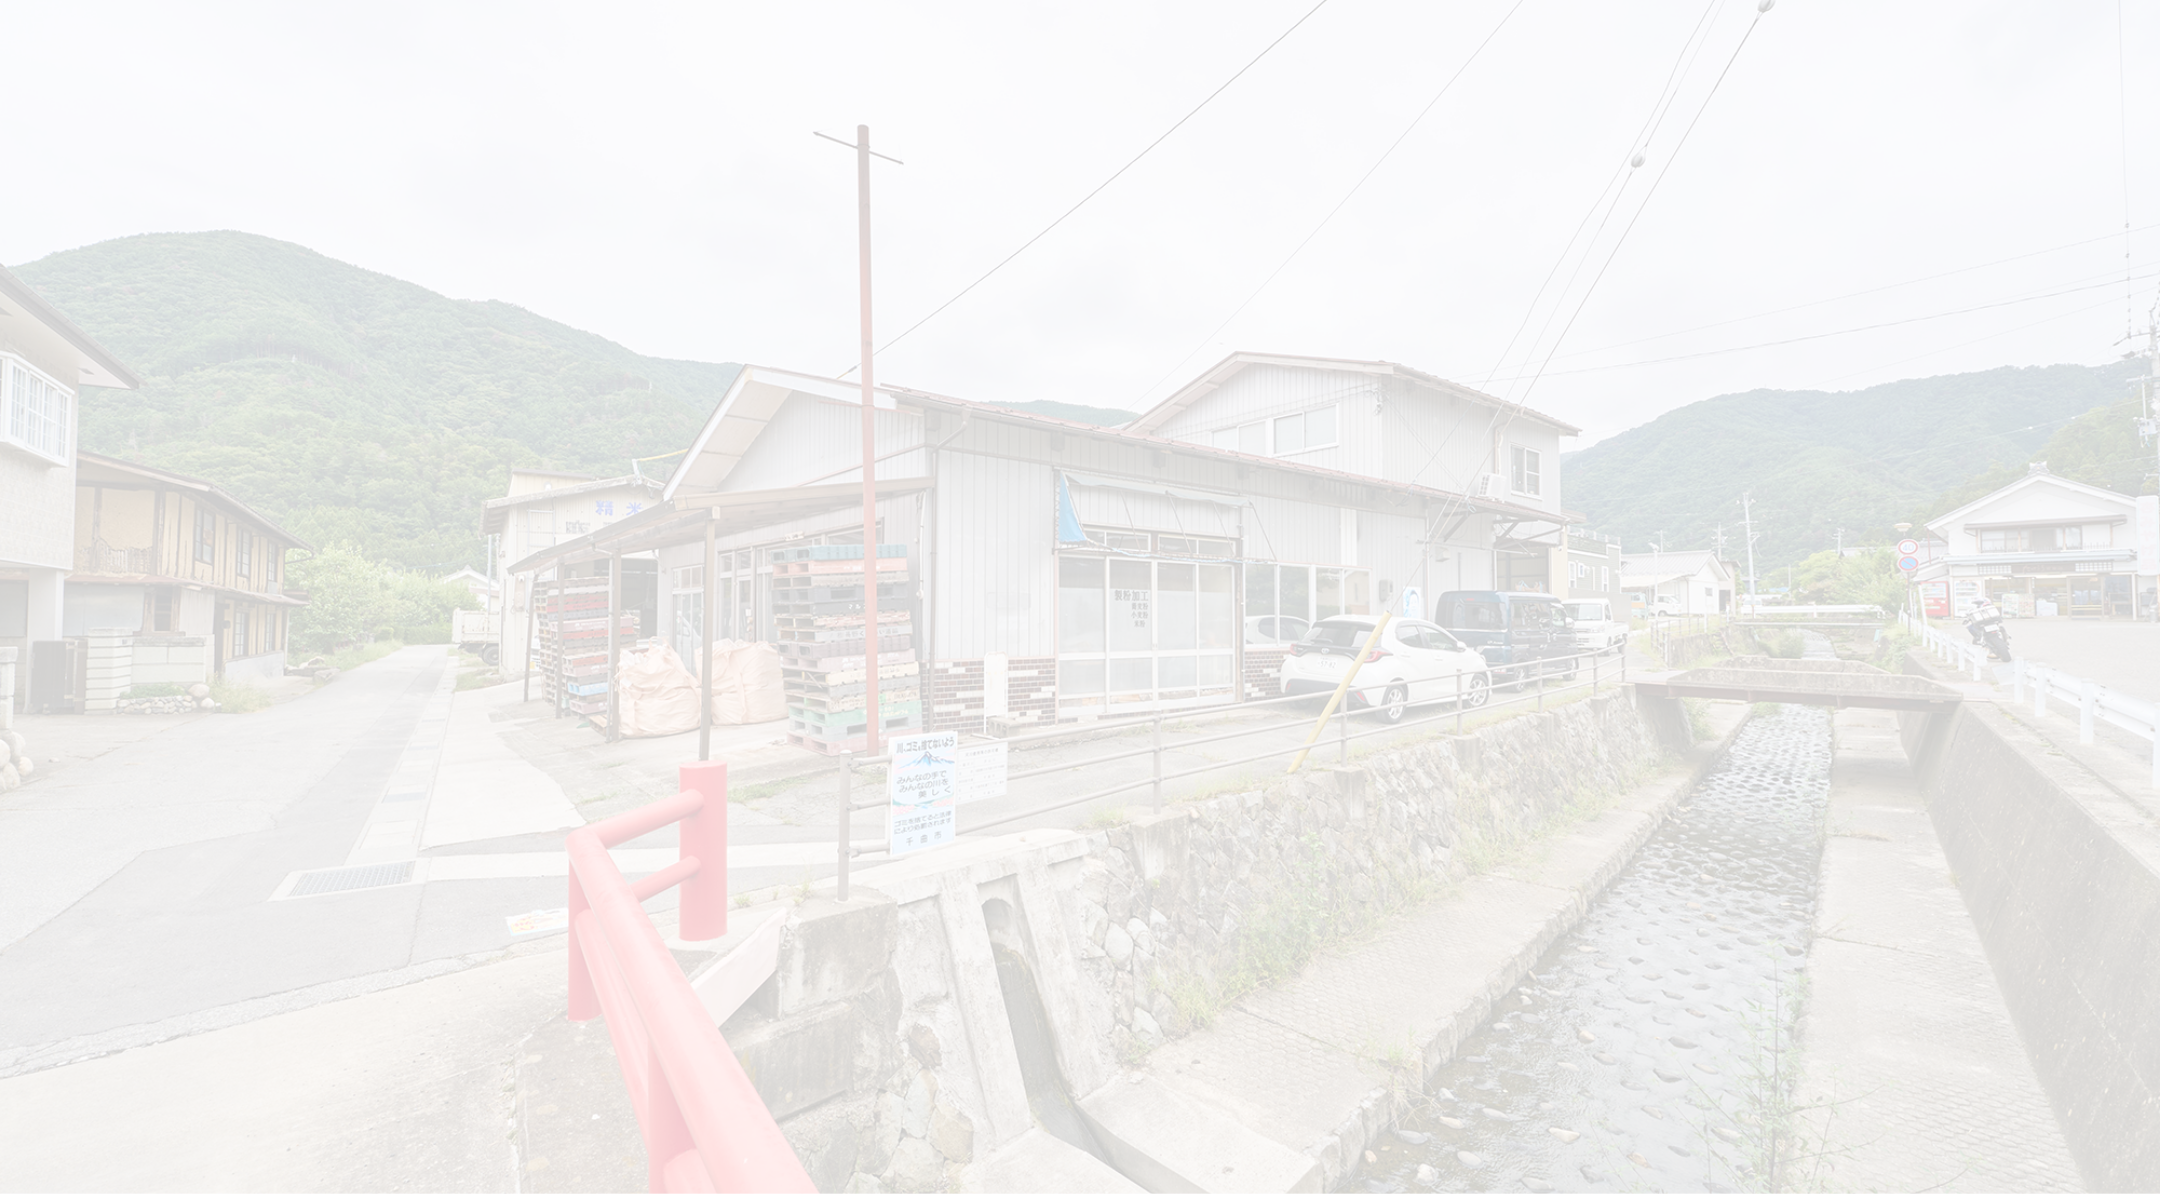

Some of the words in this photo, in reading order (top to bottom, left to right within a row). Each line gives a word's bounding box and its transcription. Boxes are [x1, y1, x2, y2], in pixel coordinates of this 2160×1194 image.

[595, 499, 644, 517] 精米
[1902, 543, 1915, 551] 40
[1115, 590, 1148, 601] 製粉加工
[1131, 611, 1148, 619] 小麦粉
[896, 769, 947, 785] みんなの手で
[899, 778, 949, 794] みんなの川を
[918, 785, 951, 799] 美しく
[894, 810, 952, 828] ゴミを捨てると法律
[894, 817, 951, 835] により処罰されます
[906, 831, 942, 847] 千曲市
